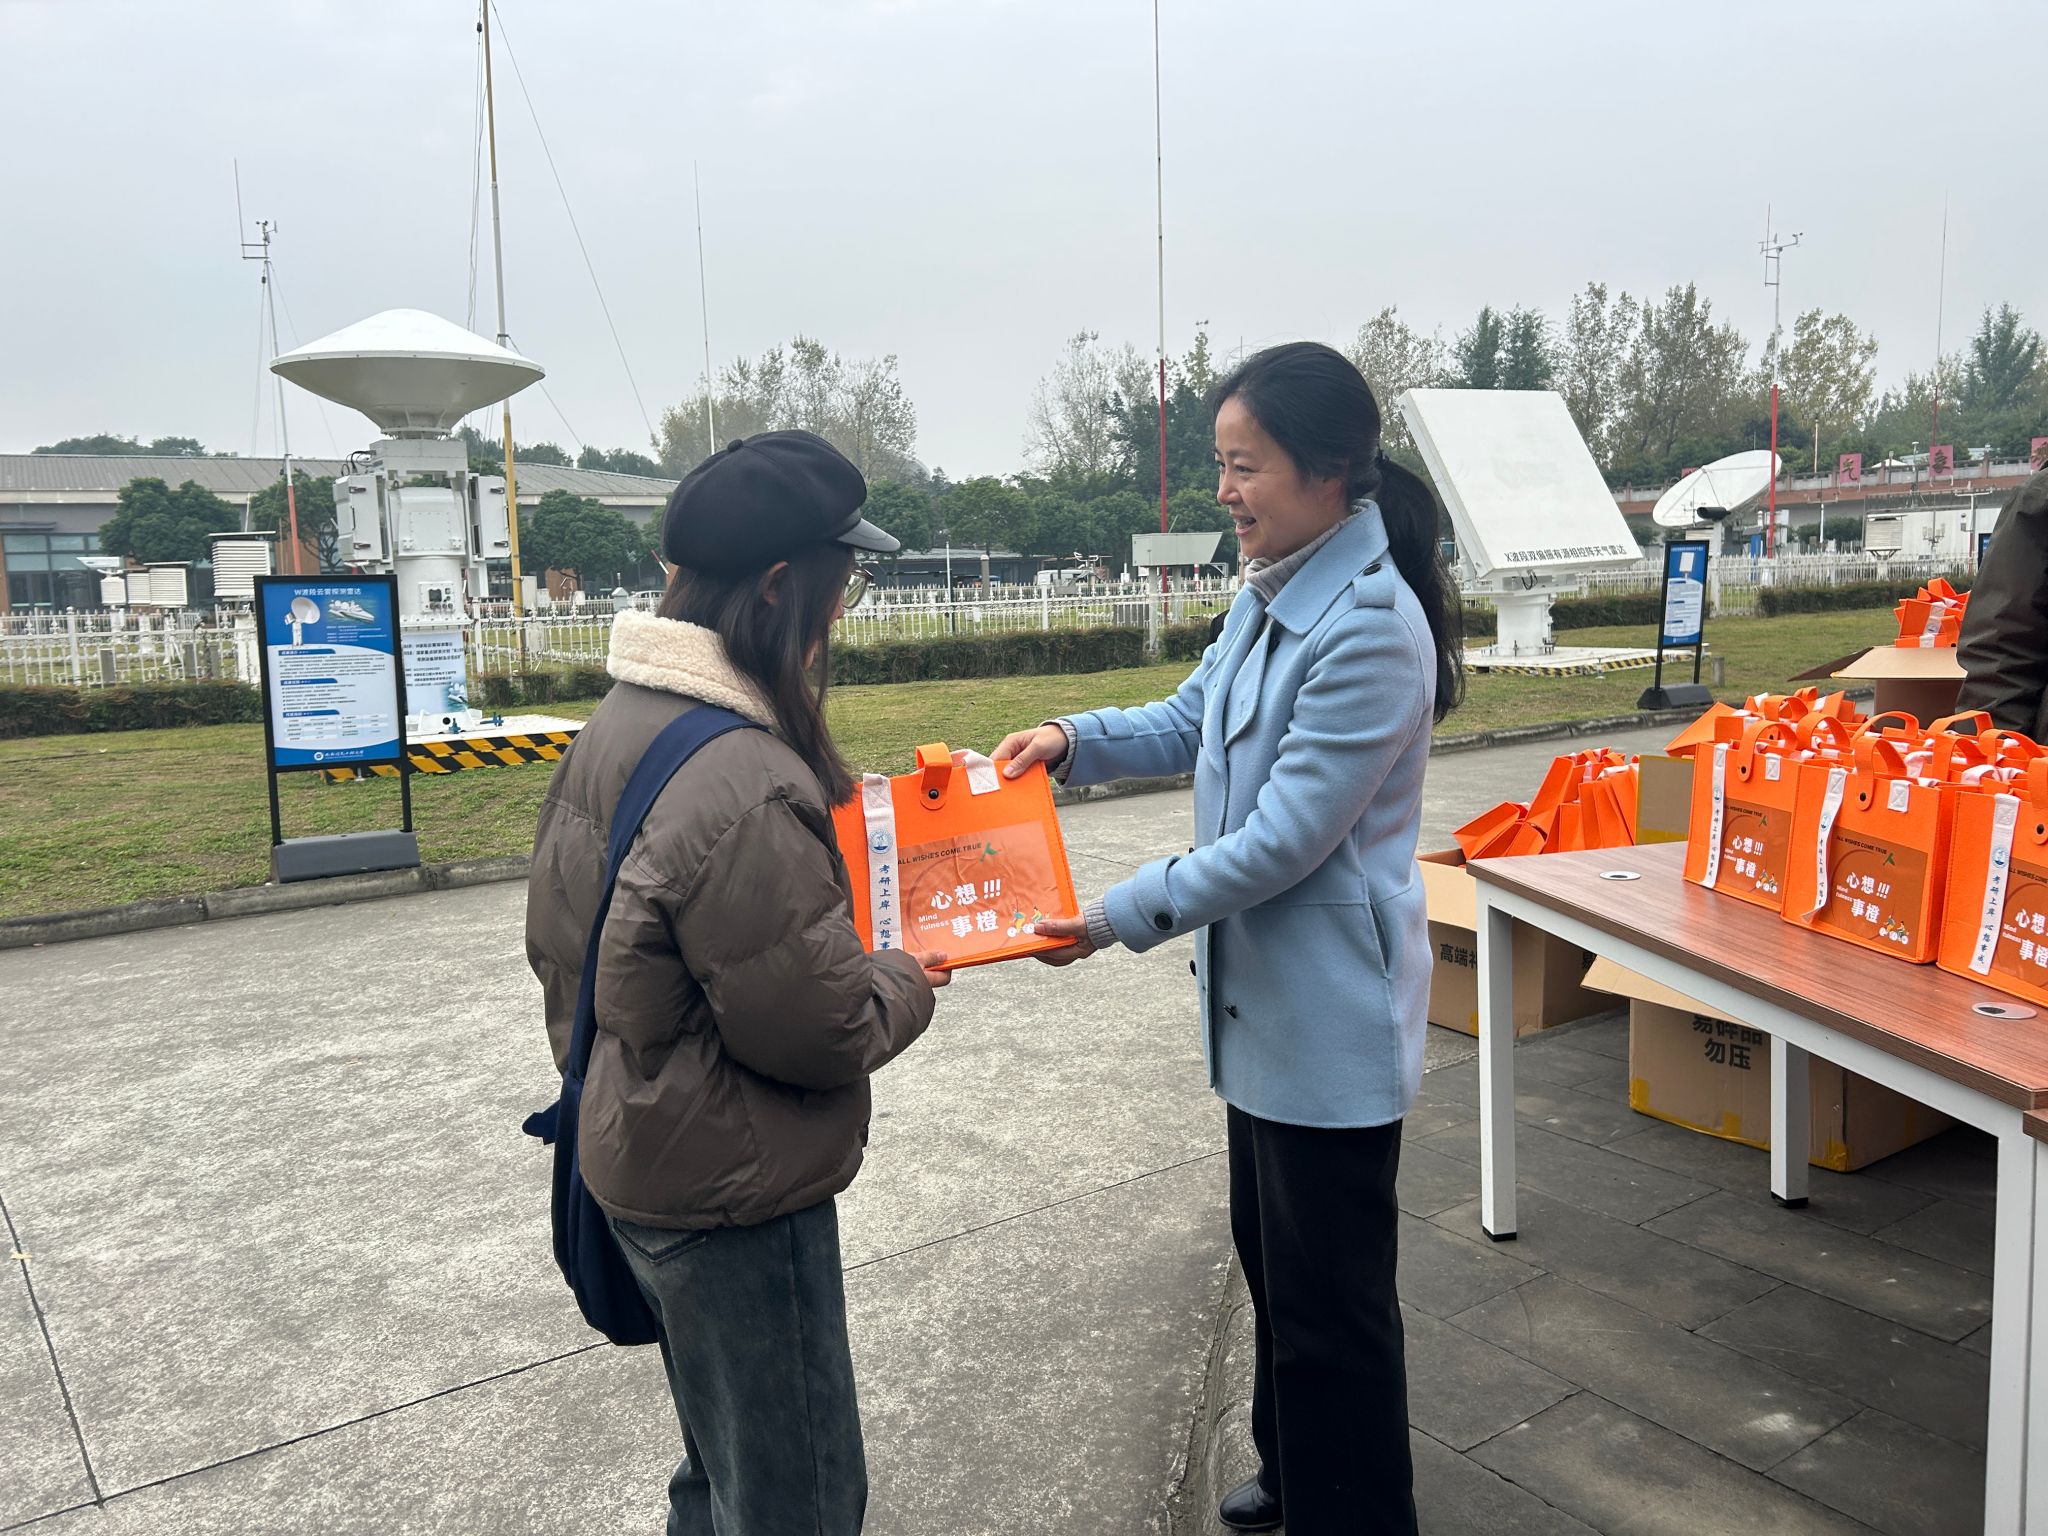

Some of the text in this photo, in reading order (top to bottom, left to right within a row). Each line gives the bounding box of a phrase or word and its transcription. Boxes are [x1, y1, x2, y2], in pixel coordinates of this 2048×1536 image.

[912, 852, 939, 862] WISHES
[940, 847, 961, 857] COME
[963, 843, 982, 852] TRUE
[1861, 842, 1875, 851] COME
[1735, 858, 1757, 878] 事橙
[879, 864, 891, 910] 考研上岸
[1836, 885, 1848, 893] Mind
[918, 913, 938, 923] Mind
[1851, 899, 1880, 923] 事橙
[920, 920, 950, 932] fulness
[950, 909, 999, 938] 事橙
[2004, 924, 2017, 933] Mind
[1704, 1038, 1751, 1070] 勿压
